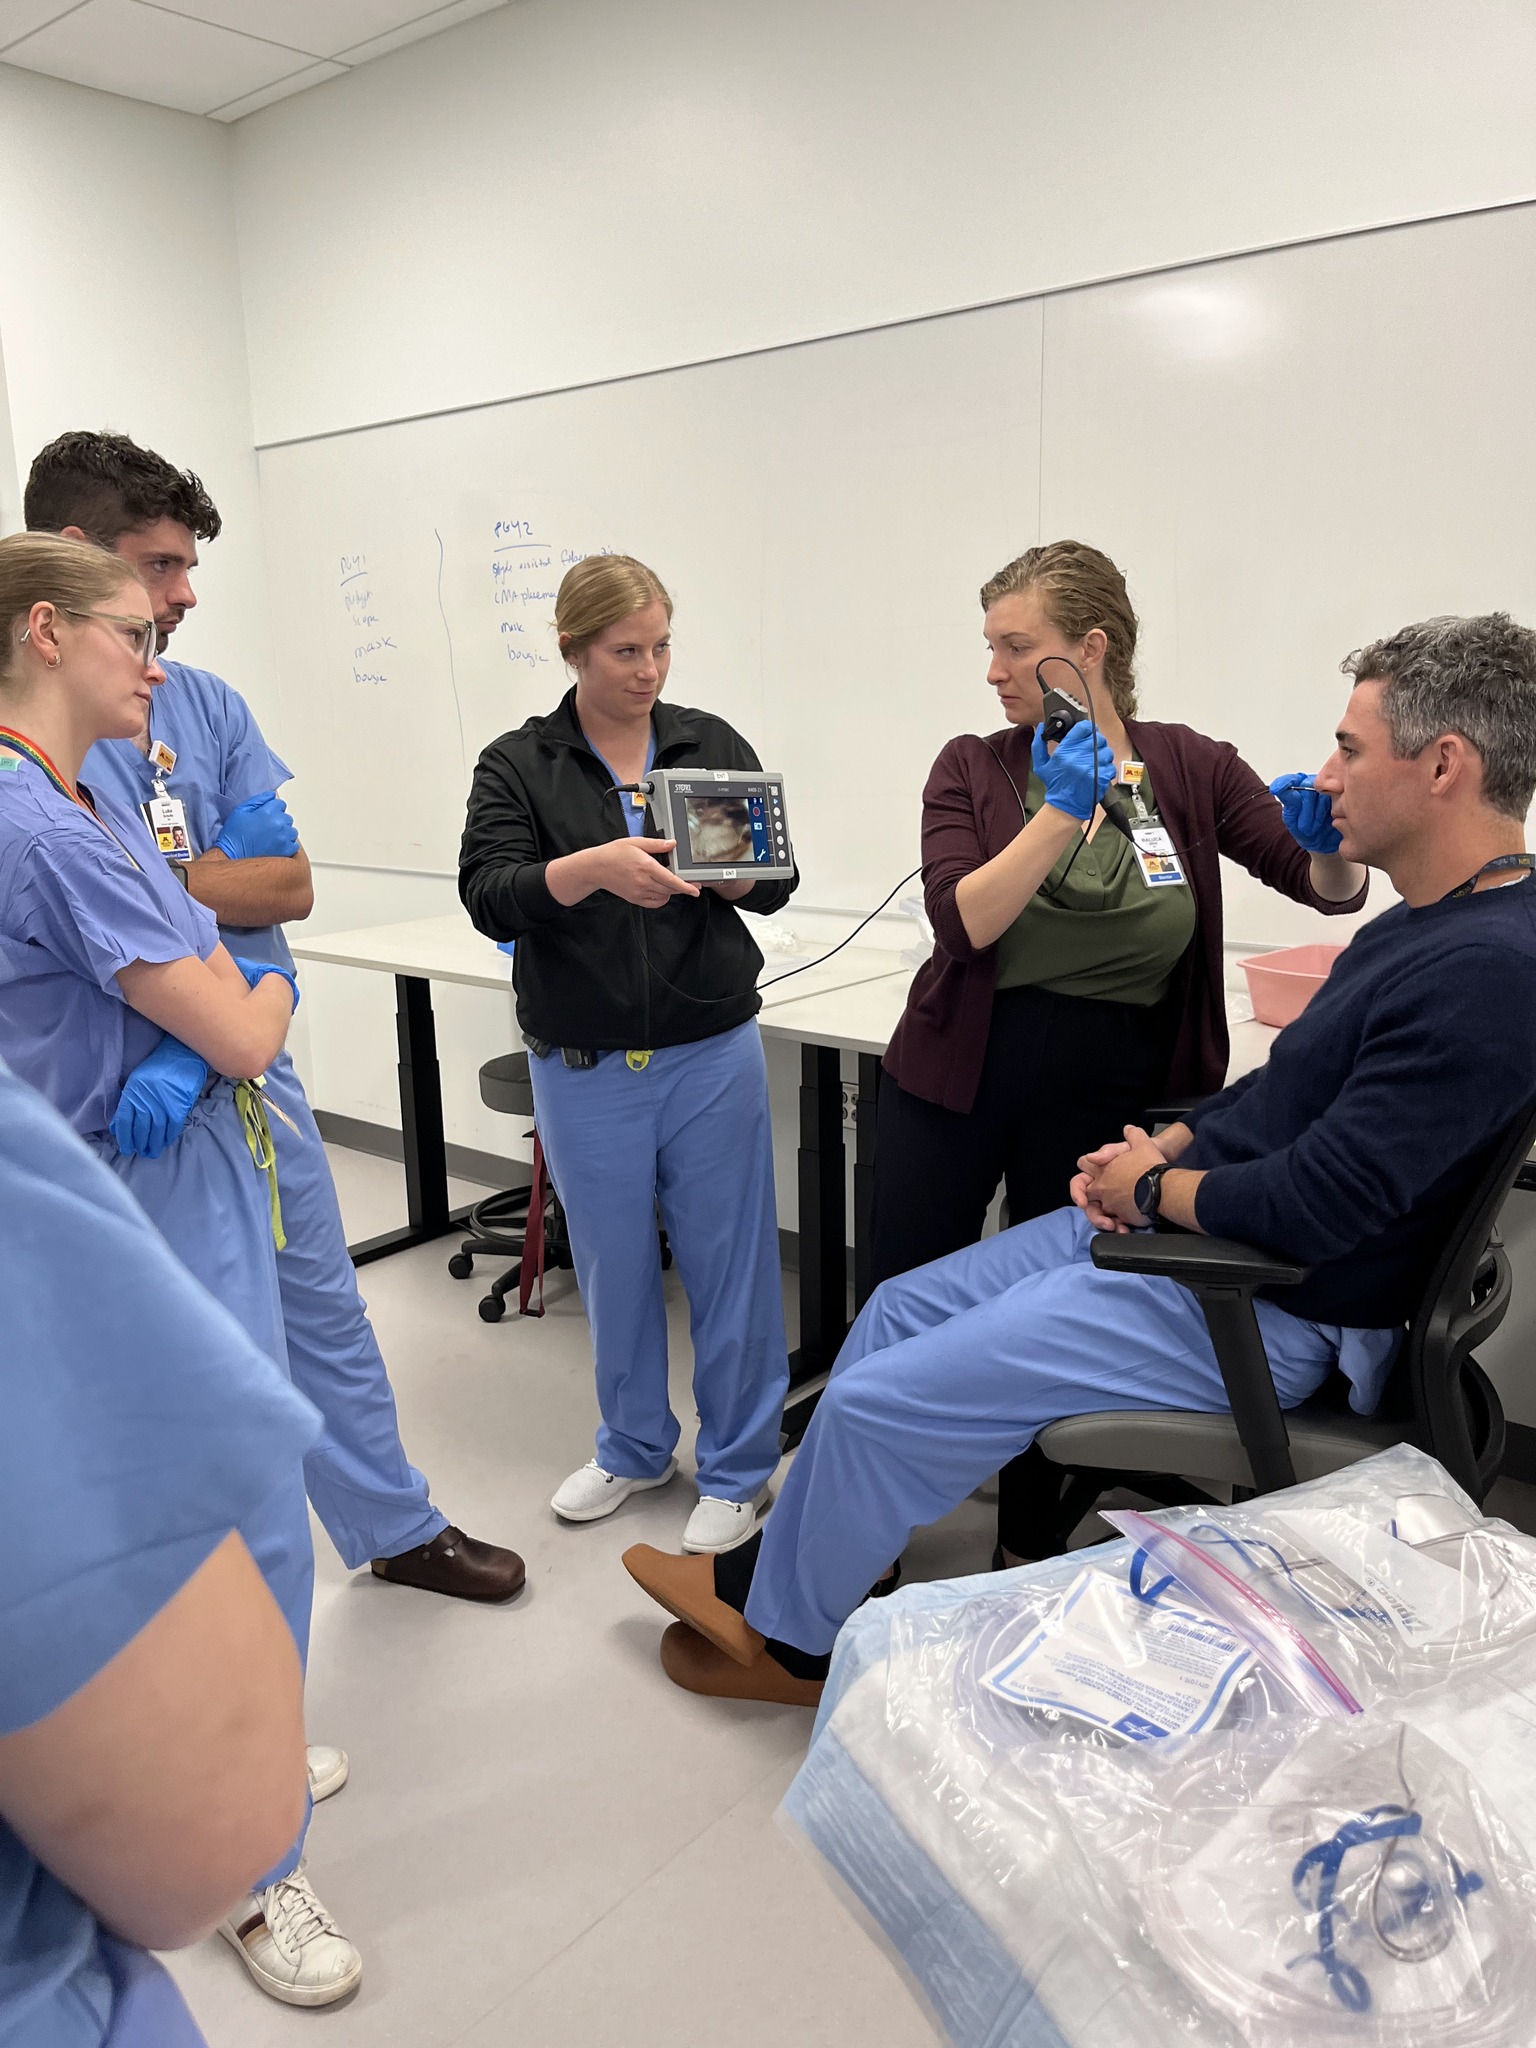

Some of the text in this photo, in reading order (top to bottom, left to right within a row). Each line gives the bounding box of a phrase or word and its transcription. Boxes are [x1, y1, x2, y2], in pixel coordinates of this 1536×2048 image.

[494, 520, 533, 538] PGY2
[354, 636, 398, 659] mask
[1376, 1587, 1432, 1633] Ziploc
